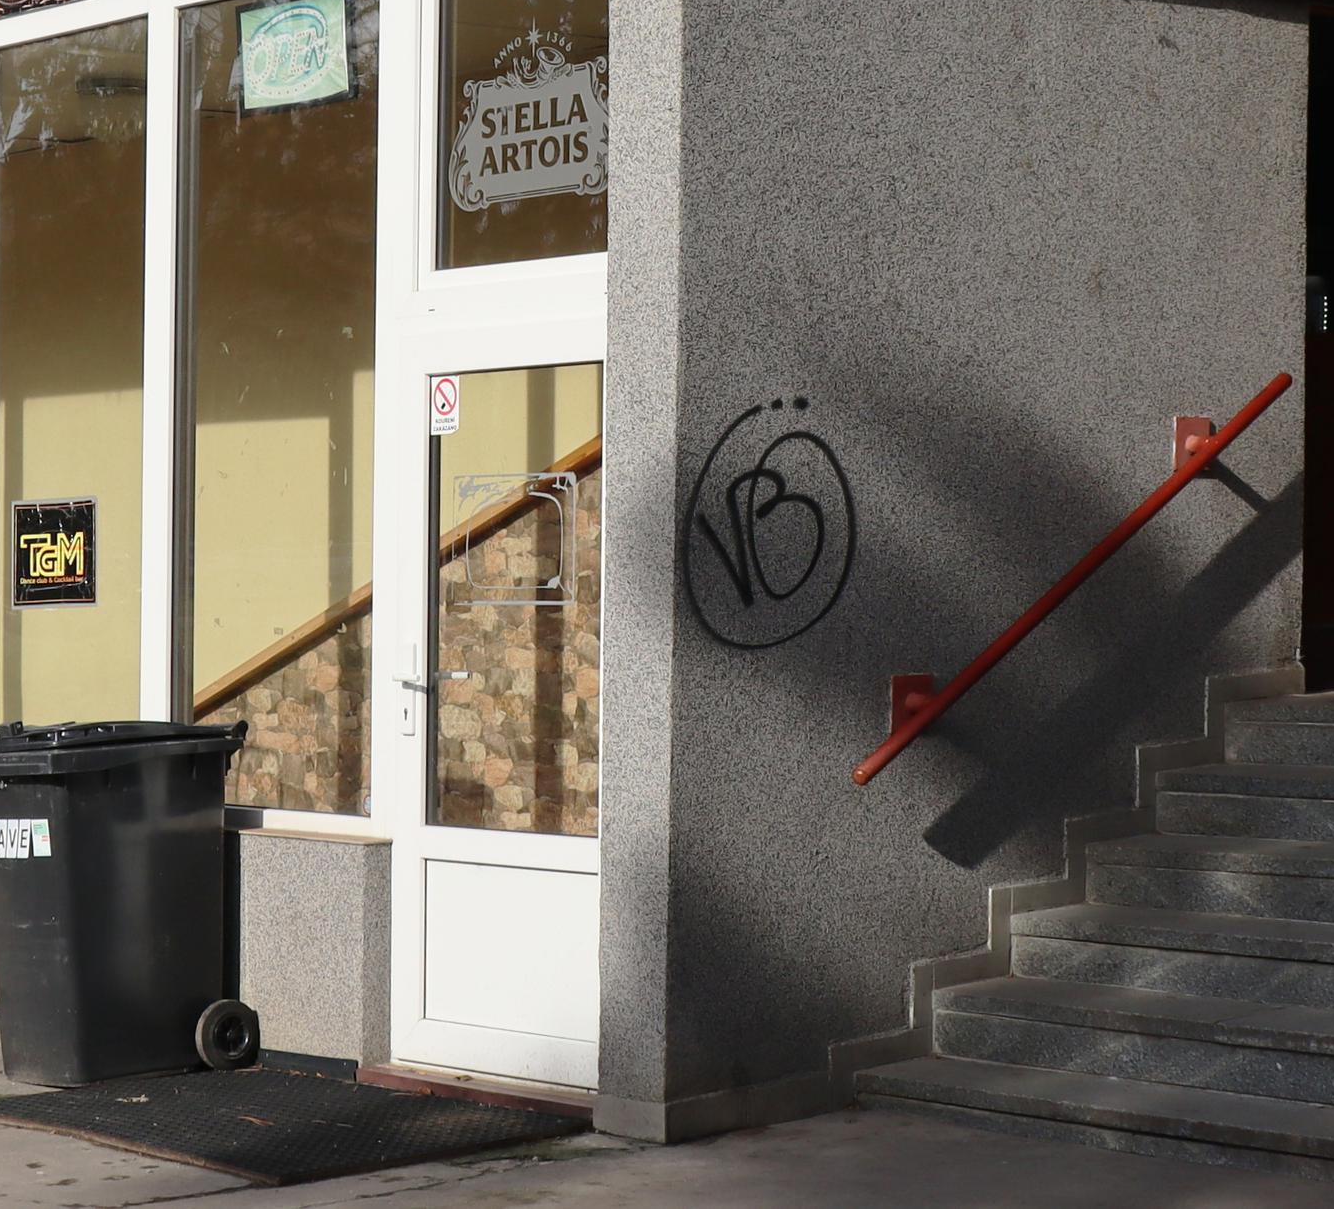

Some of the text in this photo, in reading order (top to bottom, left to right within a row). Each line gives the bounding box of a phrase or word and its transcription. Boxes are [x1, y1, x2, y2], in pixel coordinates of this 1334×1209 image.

[247, 26, 327, 85] OPEN
[493, 30, 572, 69] ANNO 1366
[481, 93, 588, 139] STELLA
[479, 130, 589, 177] ARTOIS
[20, 531, 84, 577] TGM
[20, 577, 36, 585] Dance
